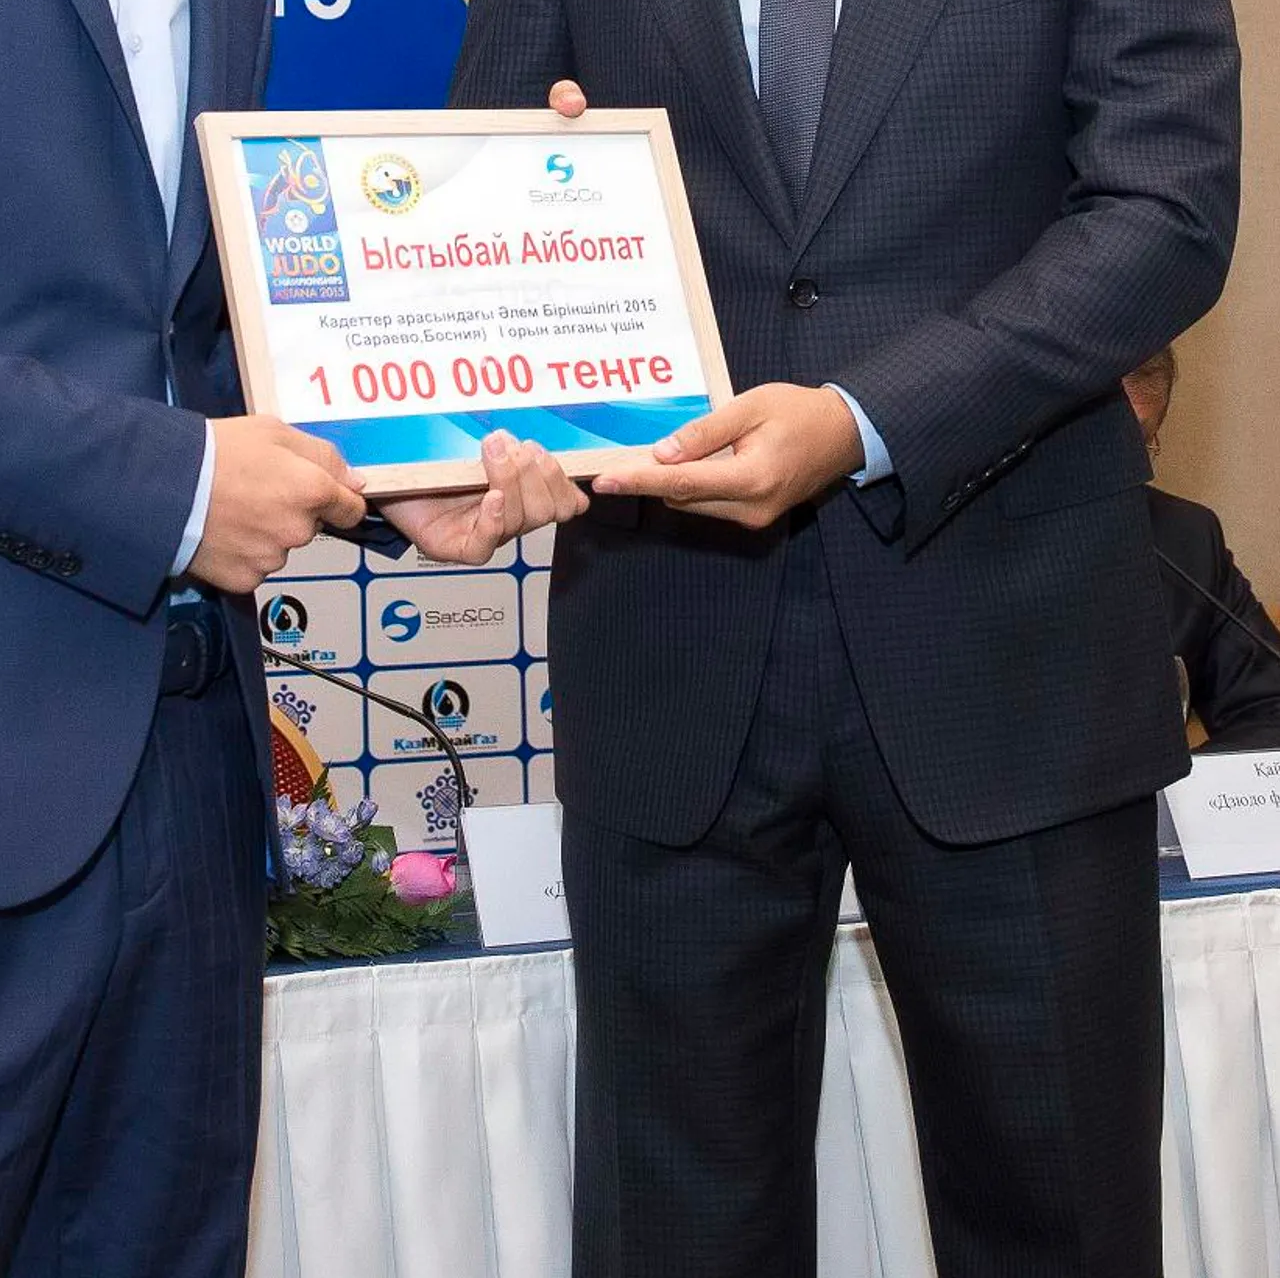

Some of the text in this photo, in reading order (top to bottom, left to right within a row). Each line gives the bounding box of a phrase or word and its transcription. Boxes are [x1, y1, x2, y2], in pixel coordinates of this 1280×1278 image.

[265, 235, 337, 254] WORLD
[361, 229, 646, 270] Ыстыбай Айболат
[272, 254, 340, 277] JUDO
[319, 314, 392, 330] Кадеттер
[499, 306, 538, 320] Әлем
[624, 299, 657, 313] 2015
[508, 324, 550, 340] орын
[308, 352, 674, 406] 1 000 000 теңге
[425, 607, 504, 623] Sat&Co
[1208, 793, 1266, 811] «Дзюдо
